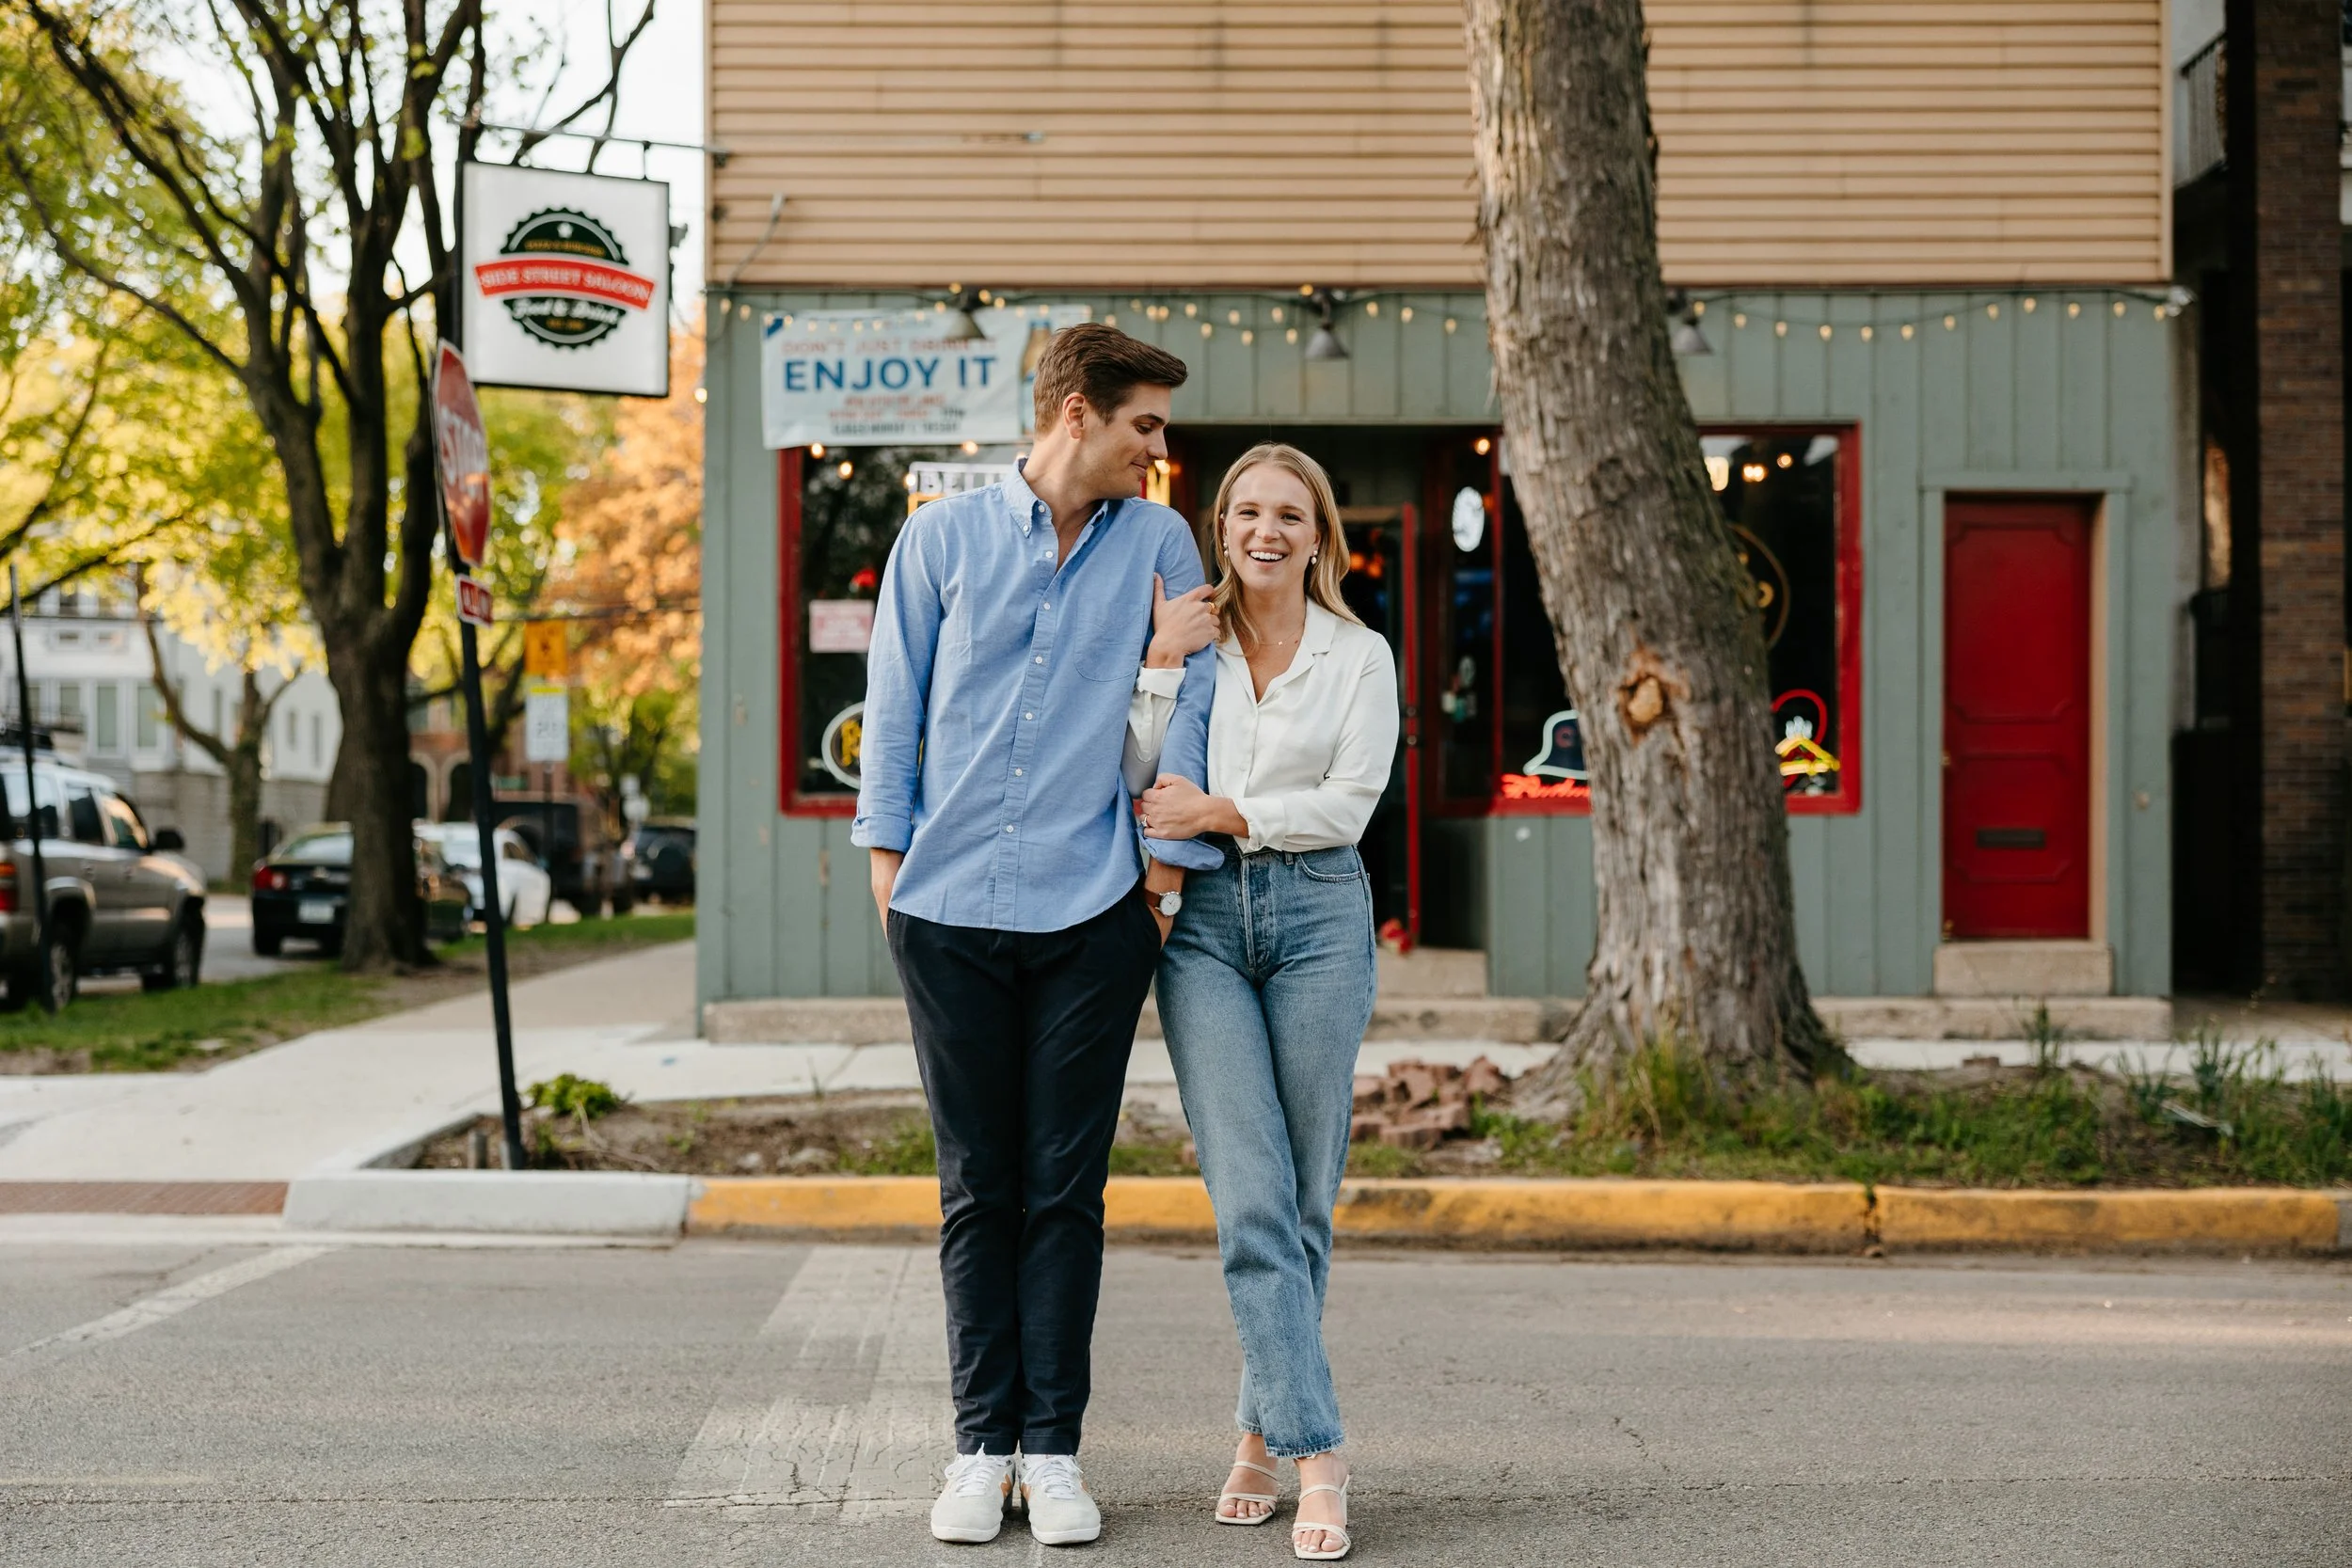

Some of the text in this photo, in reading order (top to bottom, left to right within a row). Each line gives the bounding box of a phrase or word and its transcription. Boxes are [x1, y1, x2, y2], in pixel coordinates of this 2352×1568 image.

[482, 266, 649, 300] SIDE STREET SALOON
[855, 339, 900, 355] JUST
[784, 356, 996, 391] ENJOY IT
[440, 404, 488, 505] STOP
